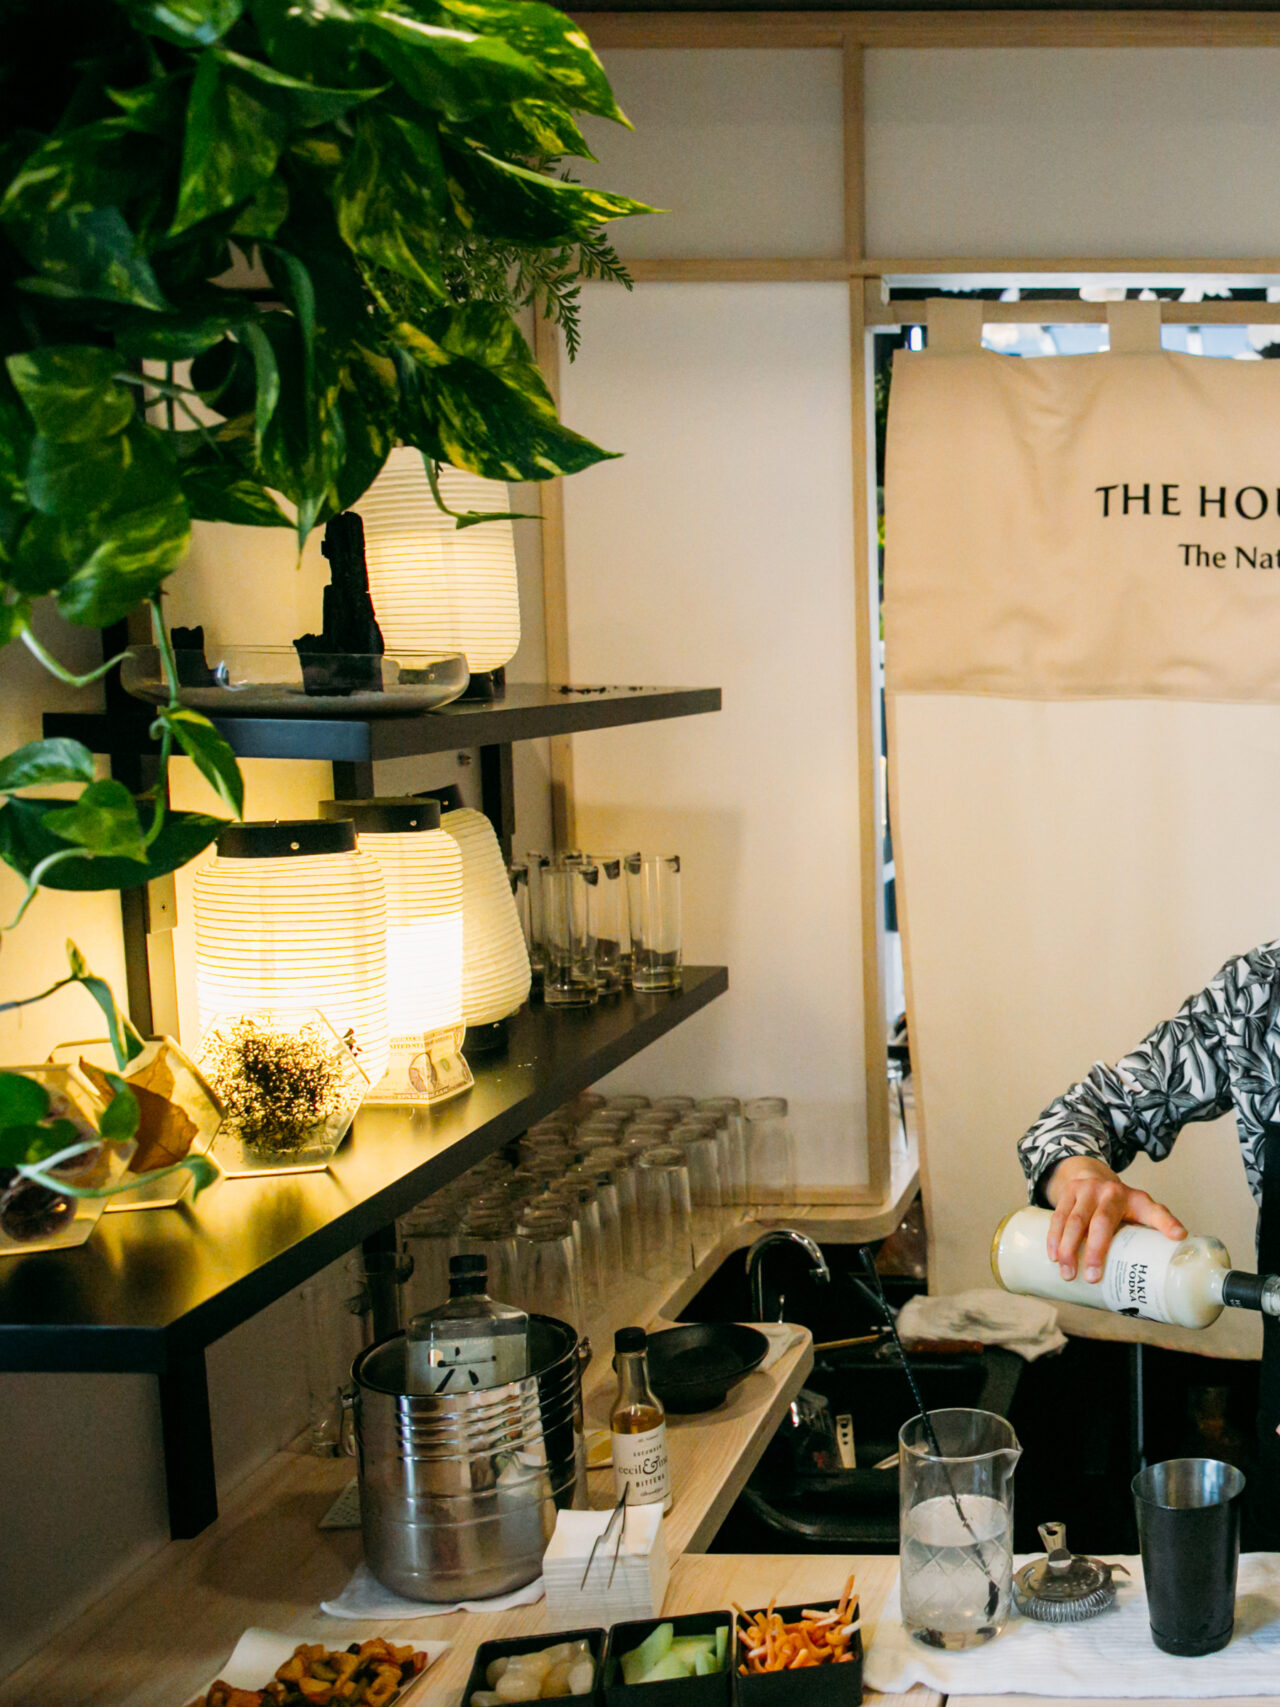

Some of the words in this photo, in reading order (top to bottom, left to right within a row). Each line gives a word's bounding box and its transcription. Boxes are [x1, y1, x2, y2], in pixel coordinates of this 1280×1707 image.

[1095, 483, 1182, 518] THE
[1179, 543, 1228, 569] The
[1128, 1263, 1139, 1302] VODKA
[1137, 1264, 1149, 1305] HAKU
